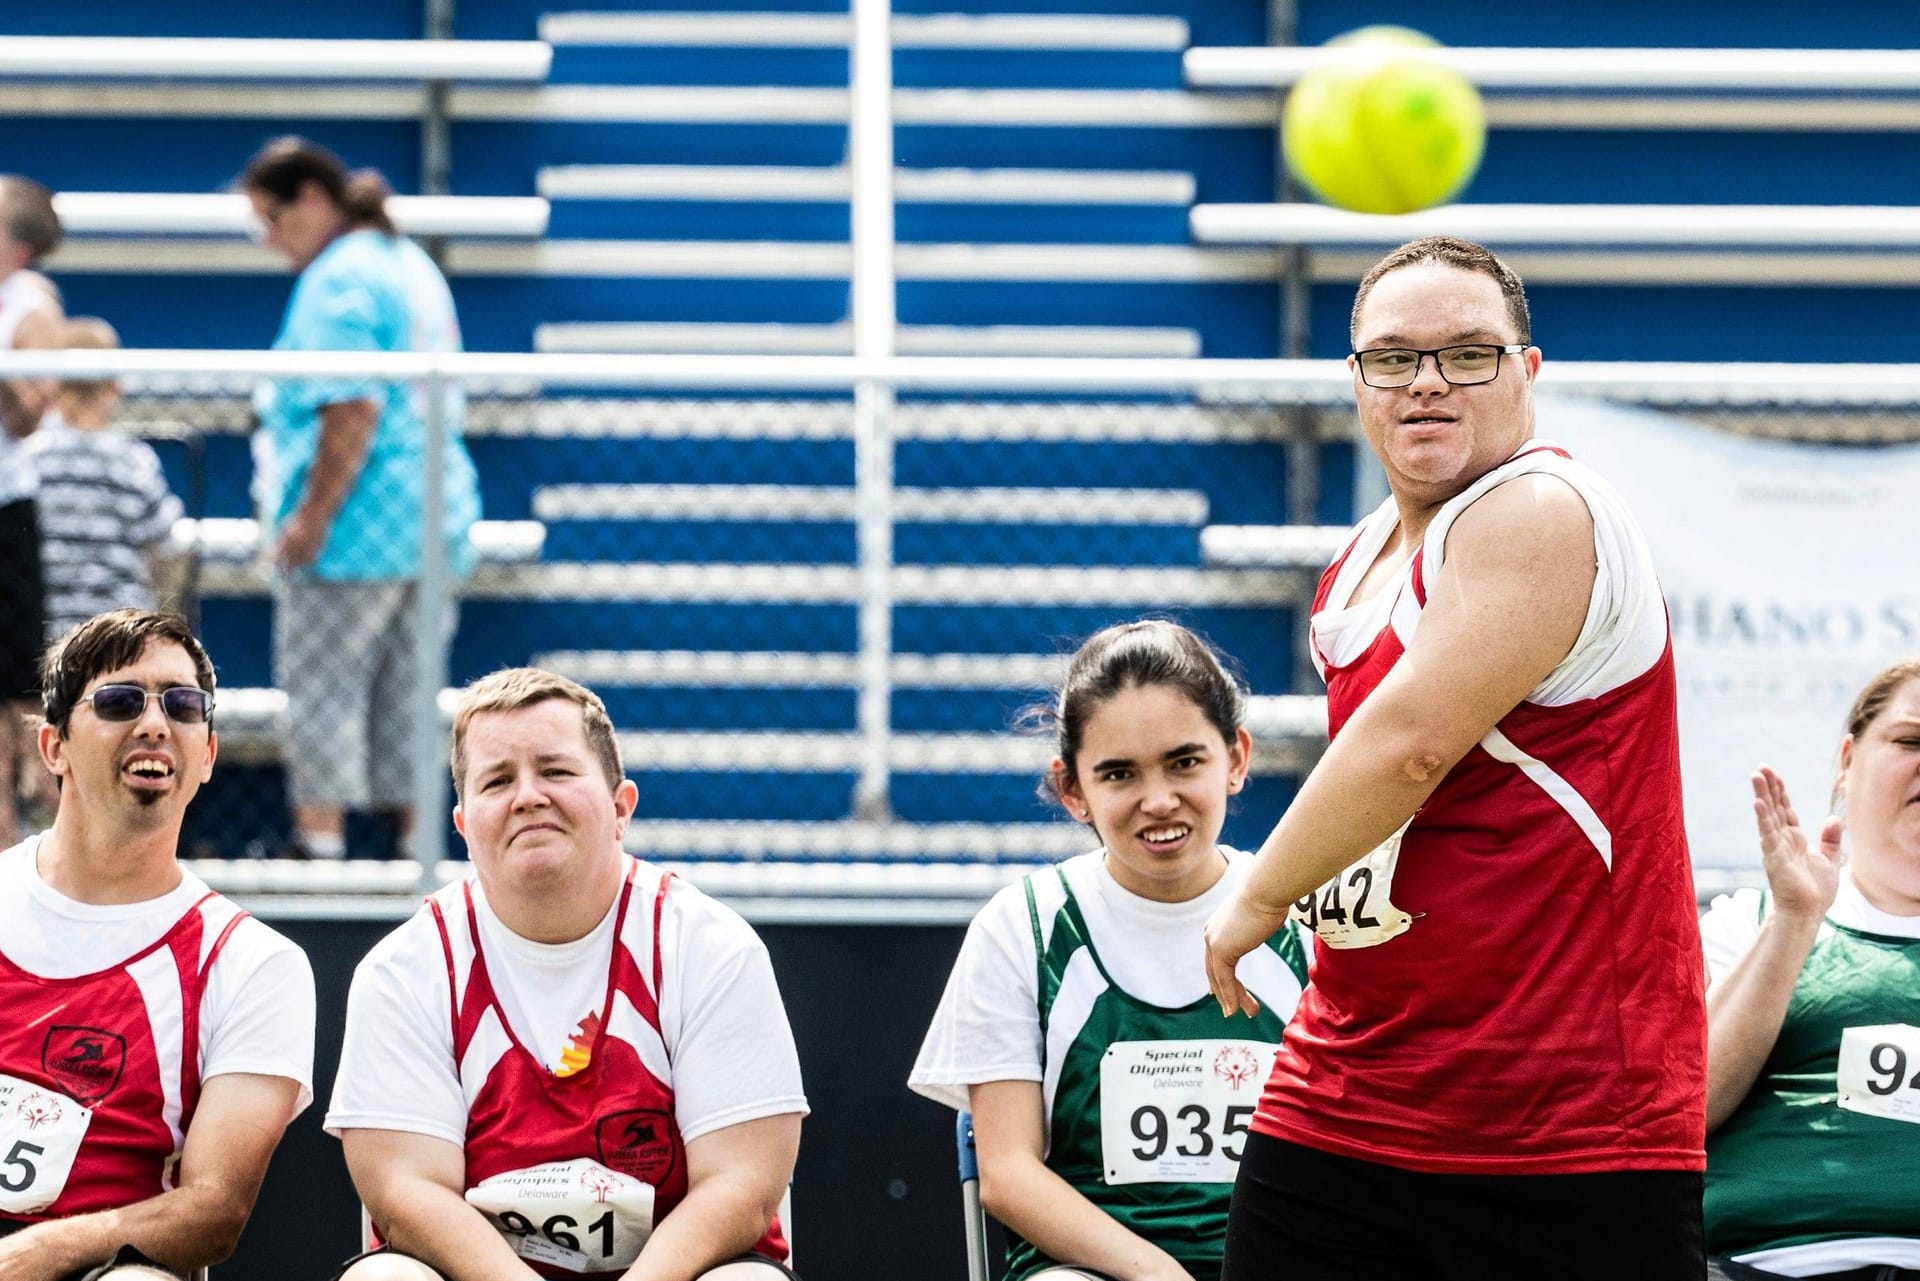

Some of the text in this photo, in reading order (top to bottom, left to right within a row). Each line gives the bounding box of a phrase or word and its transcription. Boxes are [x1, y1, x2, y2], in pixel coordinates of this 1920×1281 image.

[1295, 867, 1381, 932] 942
[1130, 1063, 1203, 1076] Olympics
[1145, 1049, 1203, 1061] Special
[1867, 1042, 1920, 1095] 9
[1153, 1078, 1203, 1088] Delaware
[1130, 1104, 1256, 1161] 935
[0, 1139, 45, 1192] 5
[518, 1187, 569, 1199] Delaware
[498, 1210, 615, 1259] 961
